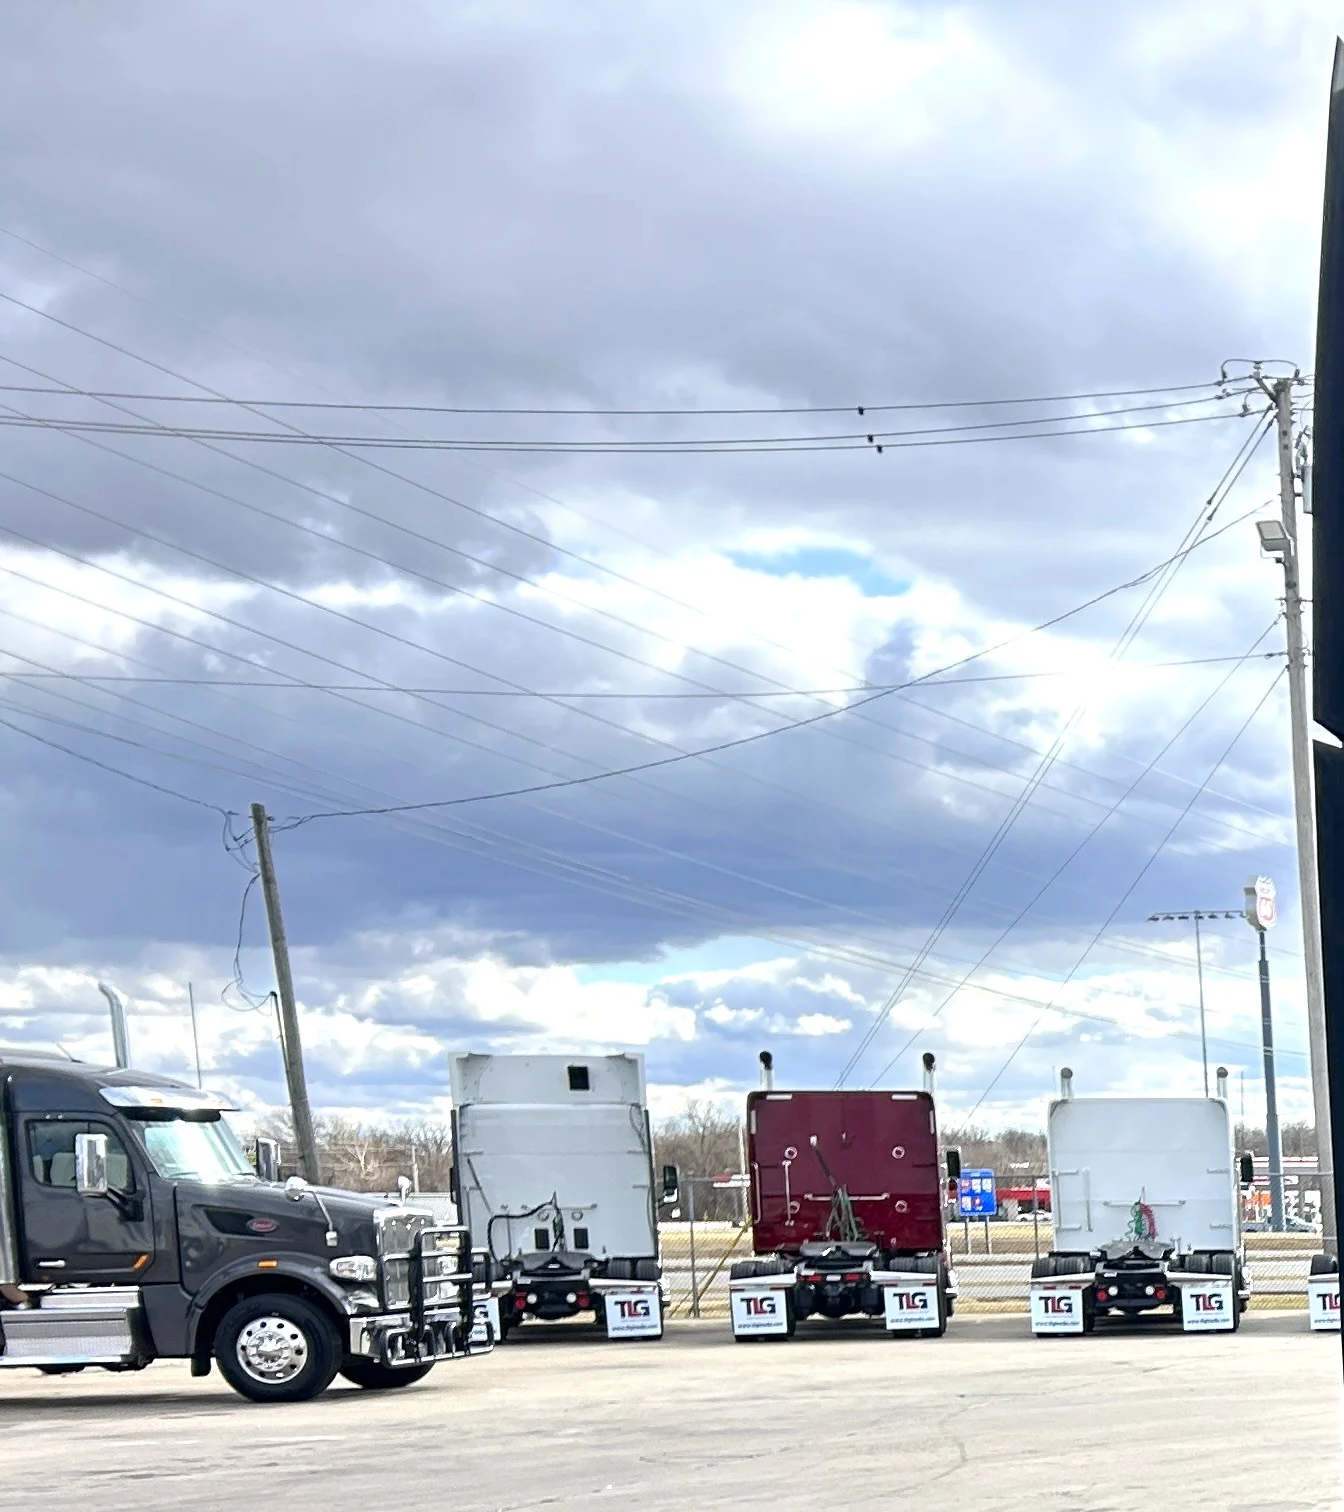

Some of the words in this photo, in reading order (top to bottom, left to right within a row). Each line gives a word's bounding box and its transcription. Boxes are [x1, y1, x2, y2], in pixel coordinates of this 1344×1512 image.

[614, 1299, 650, 1317] TLG
[740, 1297, 776, 1315] TLG
[893, 1292, 928, 1310] TLG
[1039, 1296, 1073, 1313] TLG
[1190, 1294, 1223, 1311] TLG
